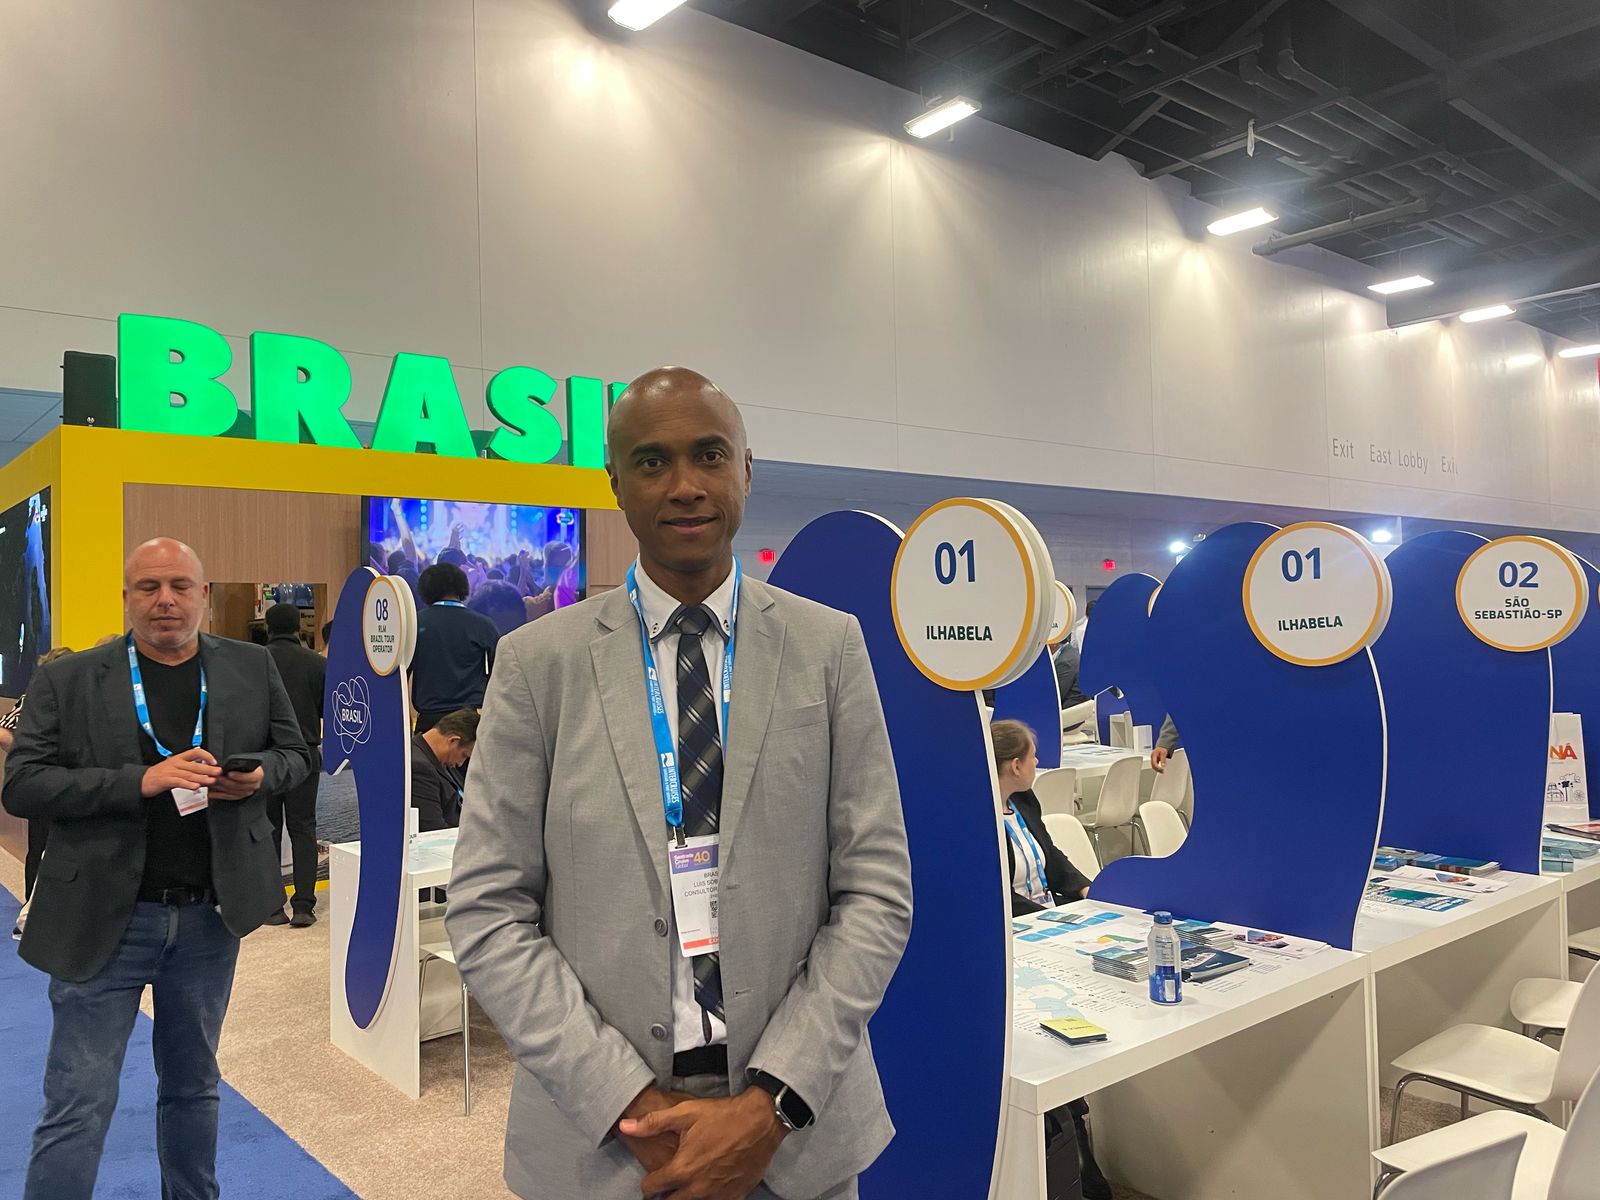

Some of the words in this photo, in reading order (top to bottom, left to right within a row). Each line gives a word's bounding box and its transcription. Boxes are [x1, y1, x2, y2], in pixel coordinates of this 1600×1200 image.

[118, 313, 630, 470] BRASI
[1332, 437, 1354, 459] Exit
[1369, 444, 1392, 465] East
[1398, 449, 1429, 475] Lobby
[934, 539, 976, 585] 01
[1281, 547, 1321, 582] 01
[1498, 561, 1539, 588] 02
[1504, 595, 1530, 608] SÃO
[375, 598, 389, 622] 08
[1474, 607, 1563, 620] SEBASTIÃO-SP
[1278, 615, 1343, 631] ILHABELA
[370, 635, 384, 644] BRAZIL
[384, 635, 395, 644] TOUR
[926, 625, 993, 641] ILHABELA
[372, 645, 393, 654] OPERATOR
[341, 708, 363, 724] BRASIL
